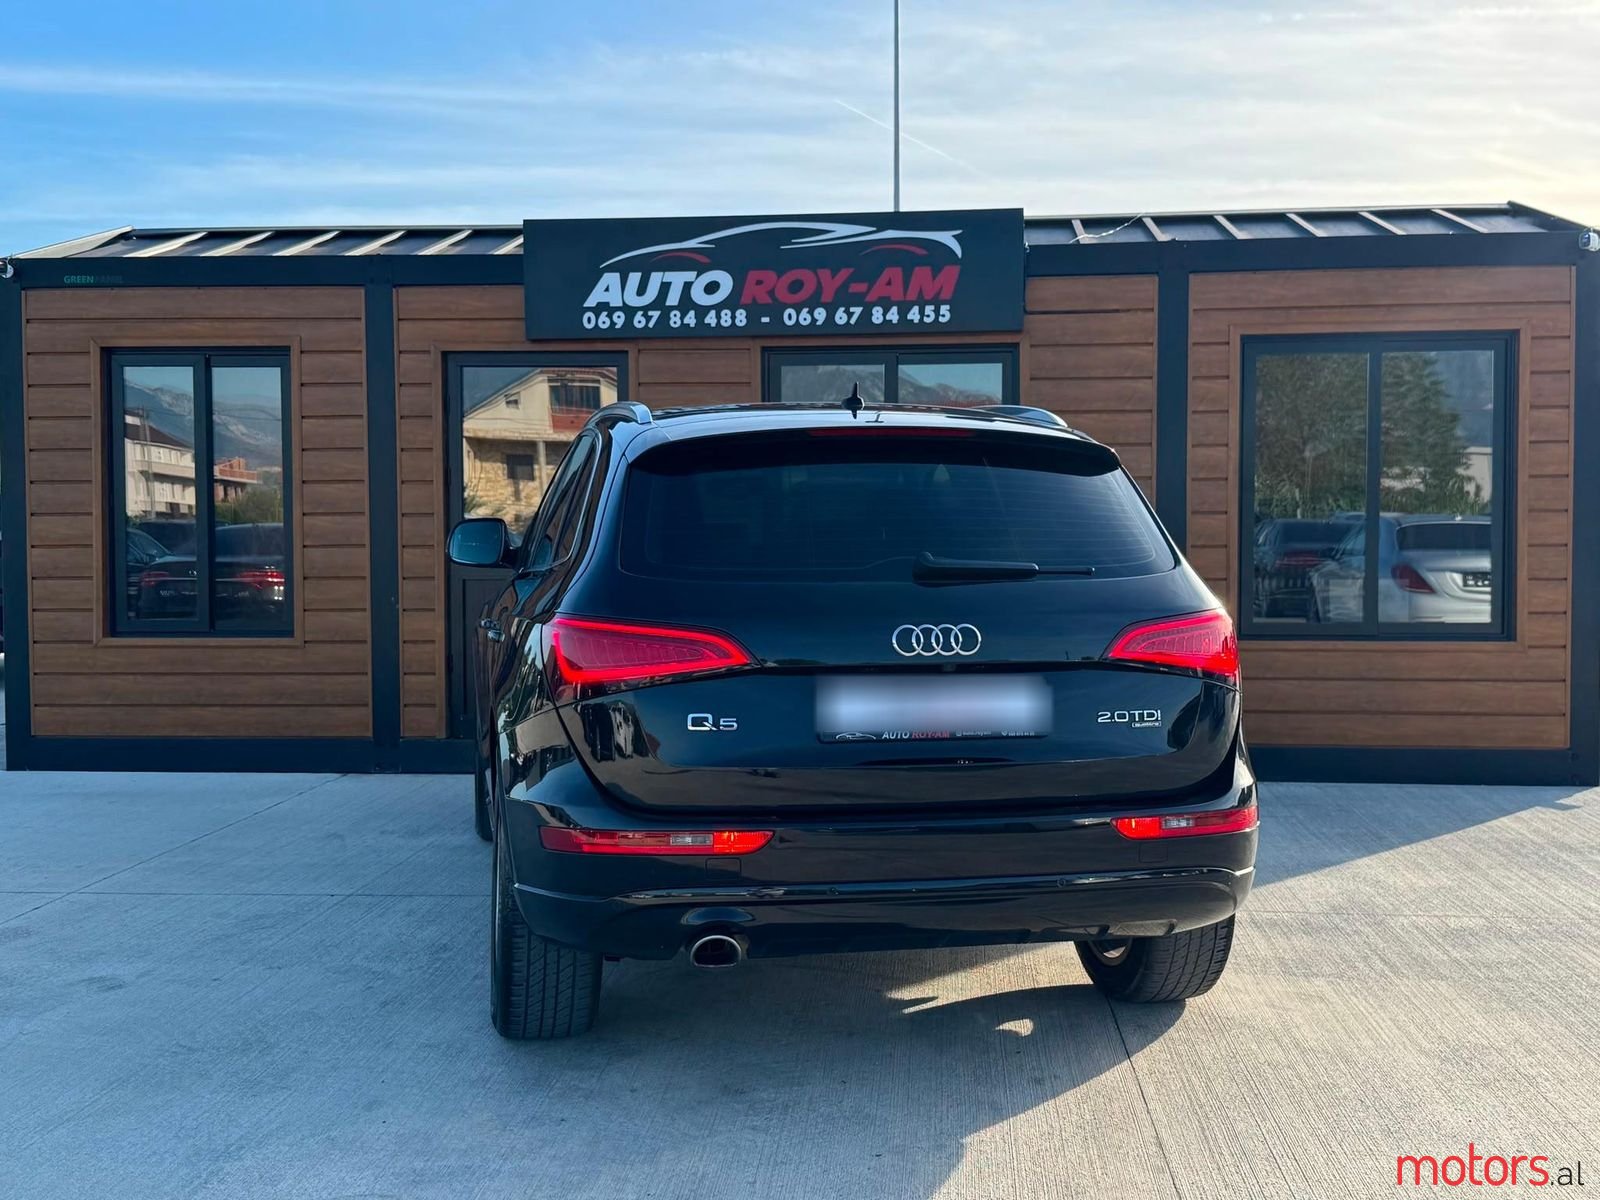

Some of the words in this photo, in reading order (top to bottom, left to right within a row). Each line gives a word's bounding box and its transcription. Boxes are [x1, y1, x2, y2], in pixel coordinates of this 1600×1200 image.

[583, 269, 734, 308] AUTO
[739, 265, 961, 305] ROY-AM
[582, 311, 625, 329] 069
[633, 310, 662, 329] 67
[669, 309, 697, 328] 84
[704, 308, 748, 327] 488
[783, 307, 827, 327] 069
[834, 306, 863, 325] 67
[871, 305, 900, 325] 84
[907, 304, 951, 323] 455
[687, 713, 738, 731] Q5
[881, 731, 910, 740] AUTO
